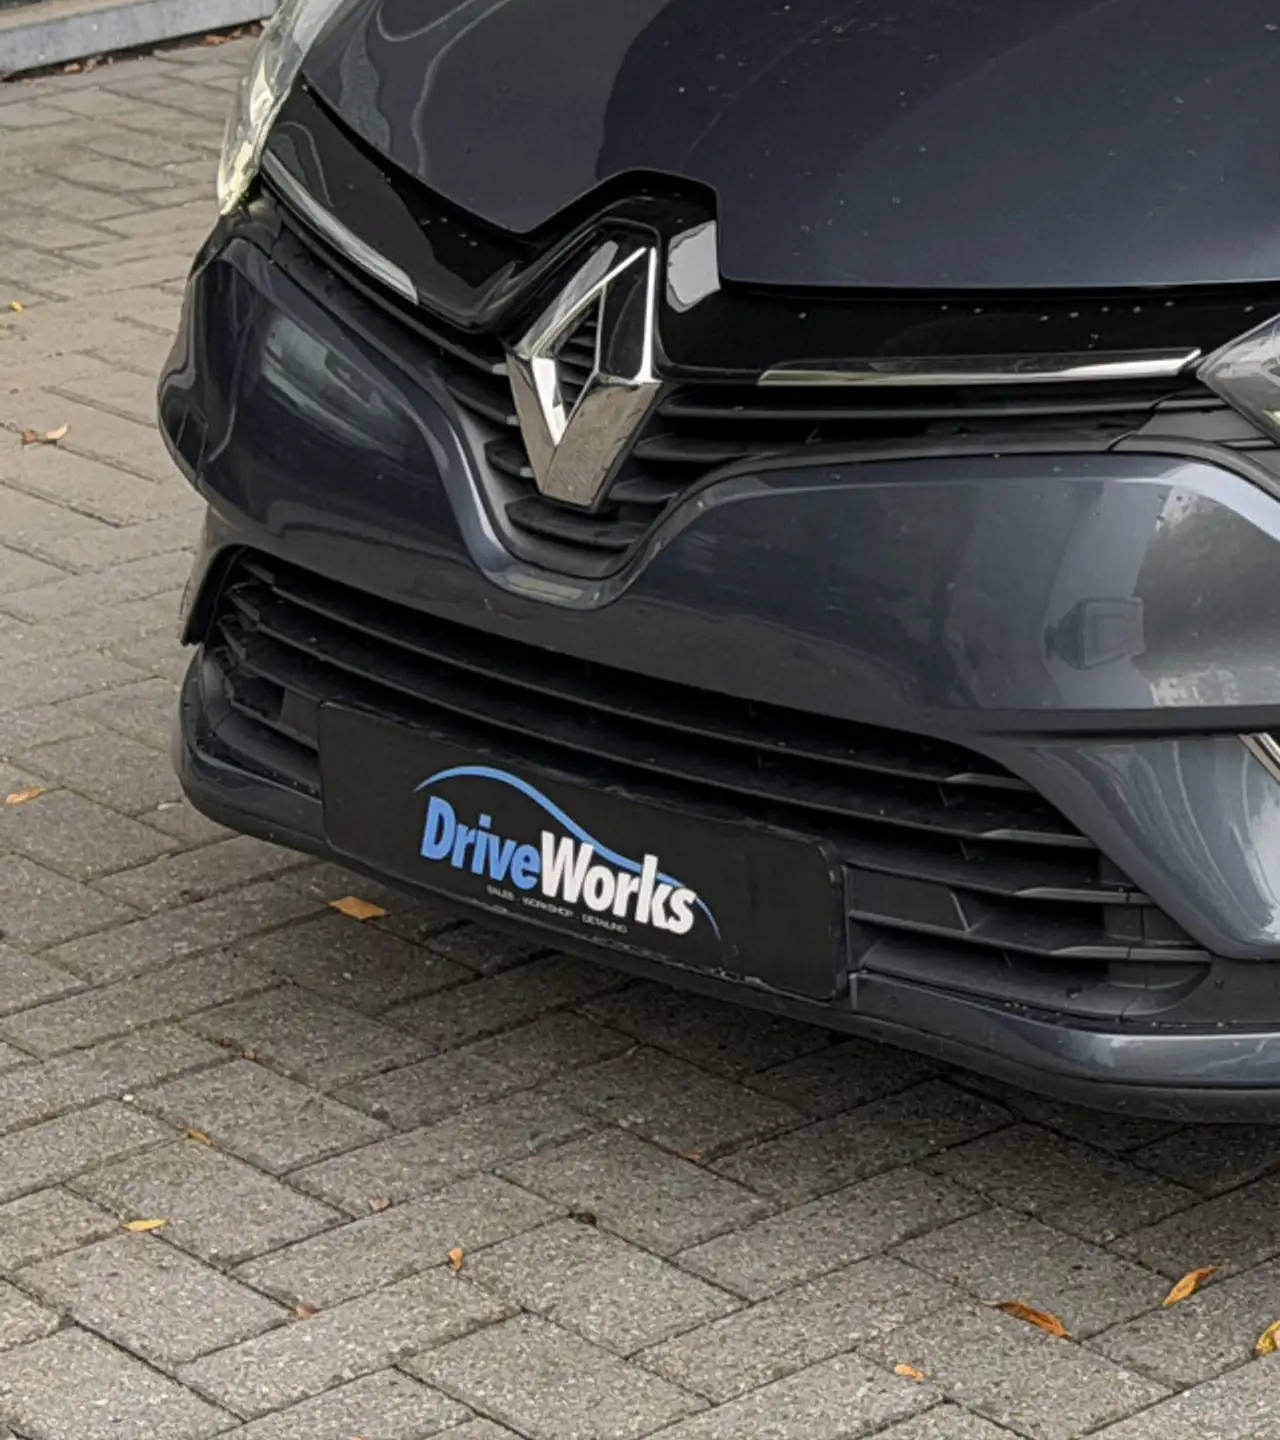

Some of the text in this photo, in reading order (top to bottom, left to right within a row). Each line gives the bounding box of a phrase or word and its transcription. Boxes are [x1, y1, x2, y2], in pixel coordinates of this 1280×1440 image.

[420, 795, 698, 935] DriveWorks
[486, 884, 516, 902] SALES
[521, 895, 574, 918] WORKSHOP
